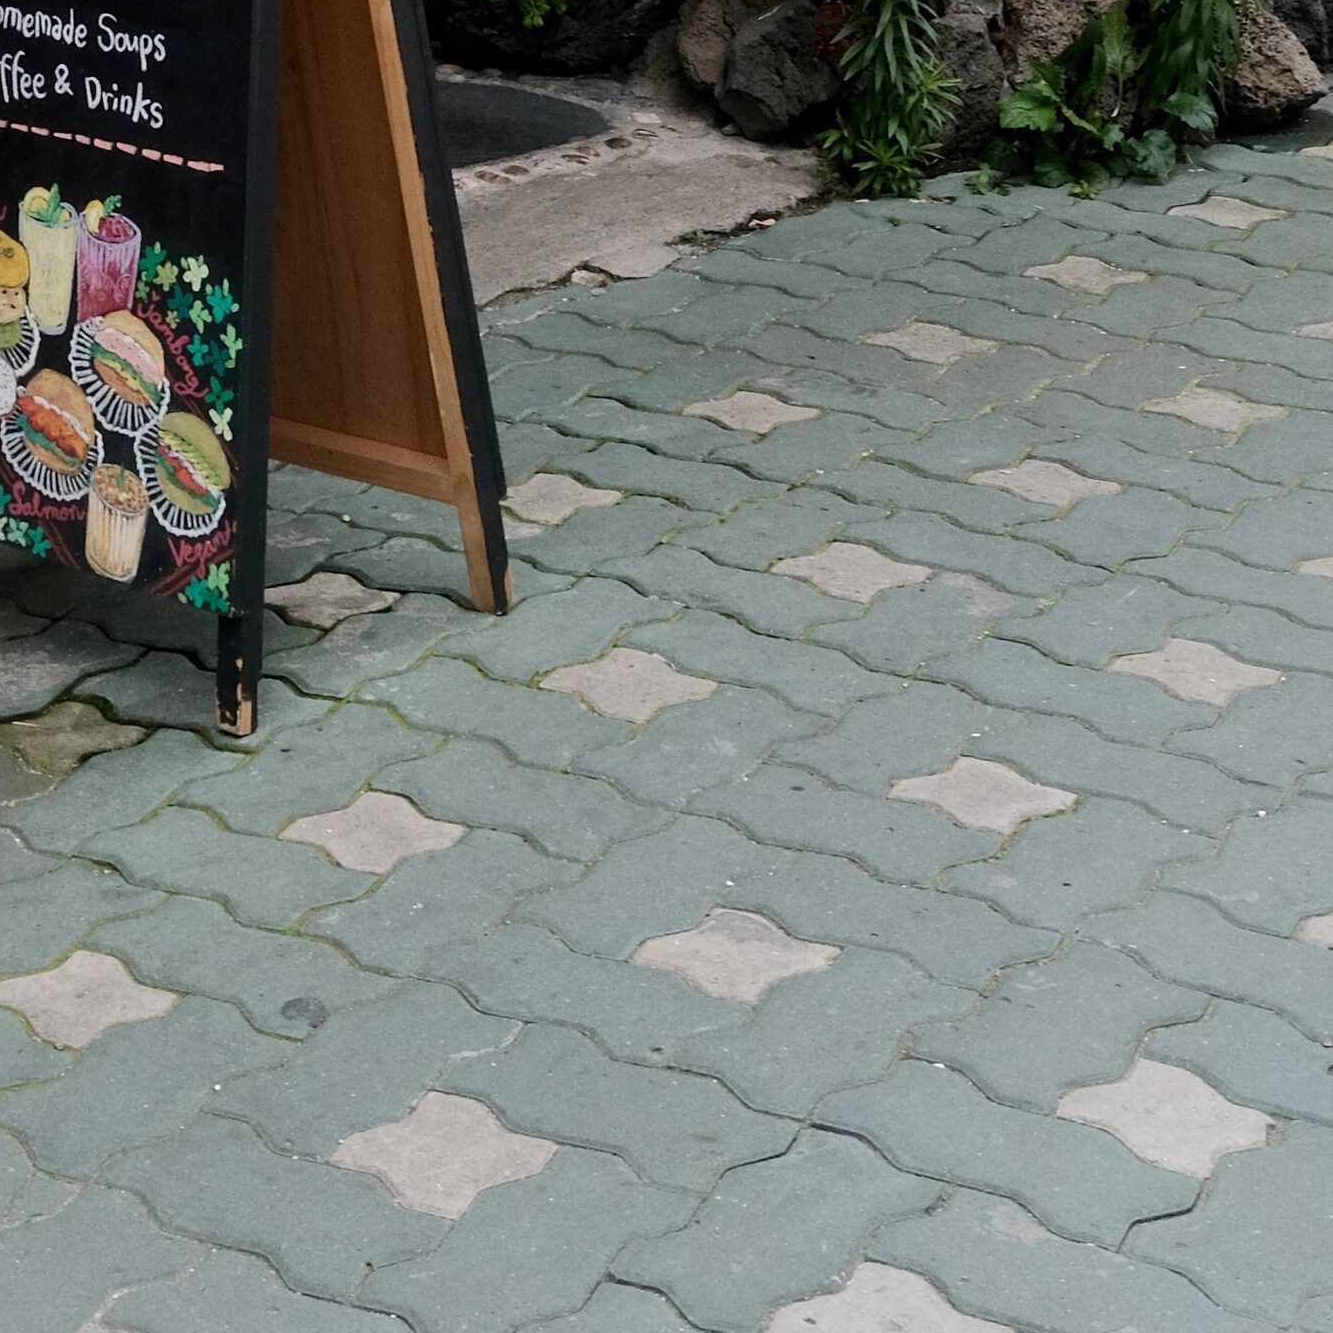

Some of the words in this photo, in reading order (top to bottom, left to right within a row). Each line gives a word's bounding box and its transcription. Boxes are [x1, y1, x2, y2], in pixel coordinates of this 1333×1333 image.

[97, 12, 166, 72] Soups
[54, 63, 74, 96] &
[84, 75, 164, 129] Drinks
